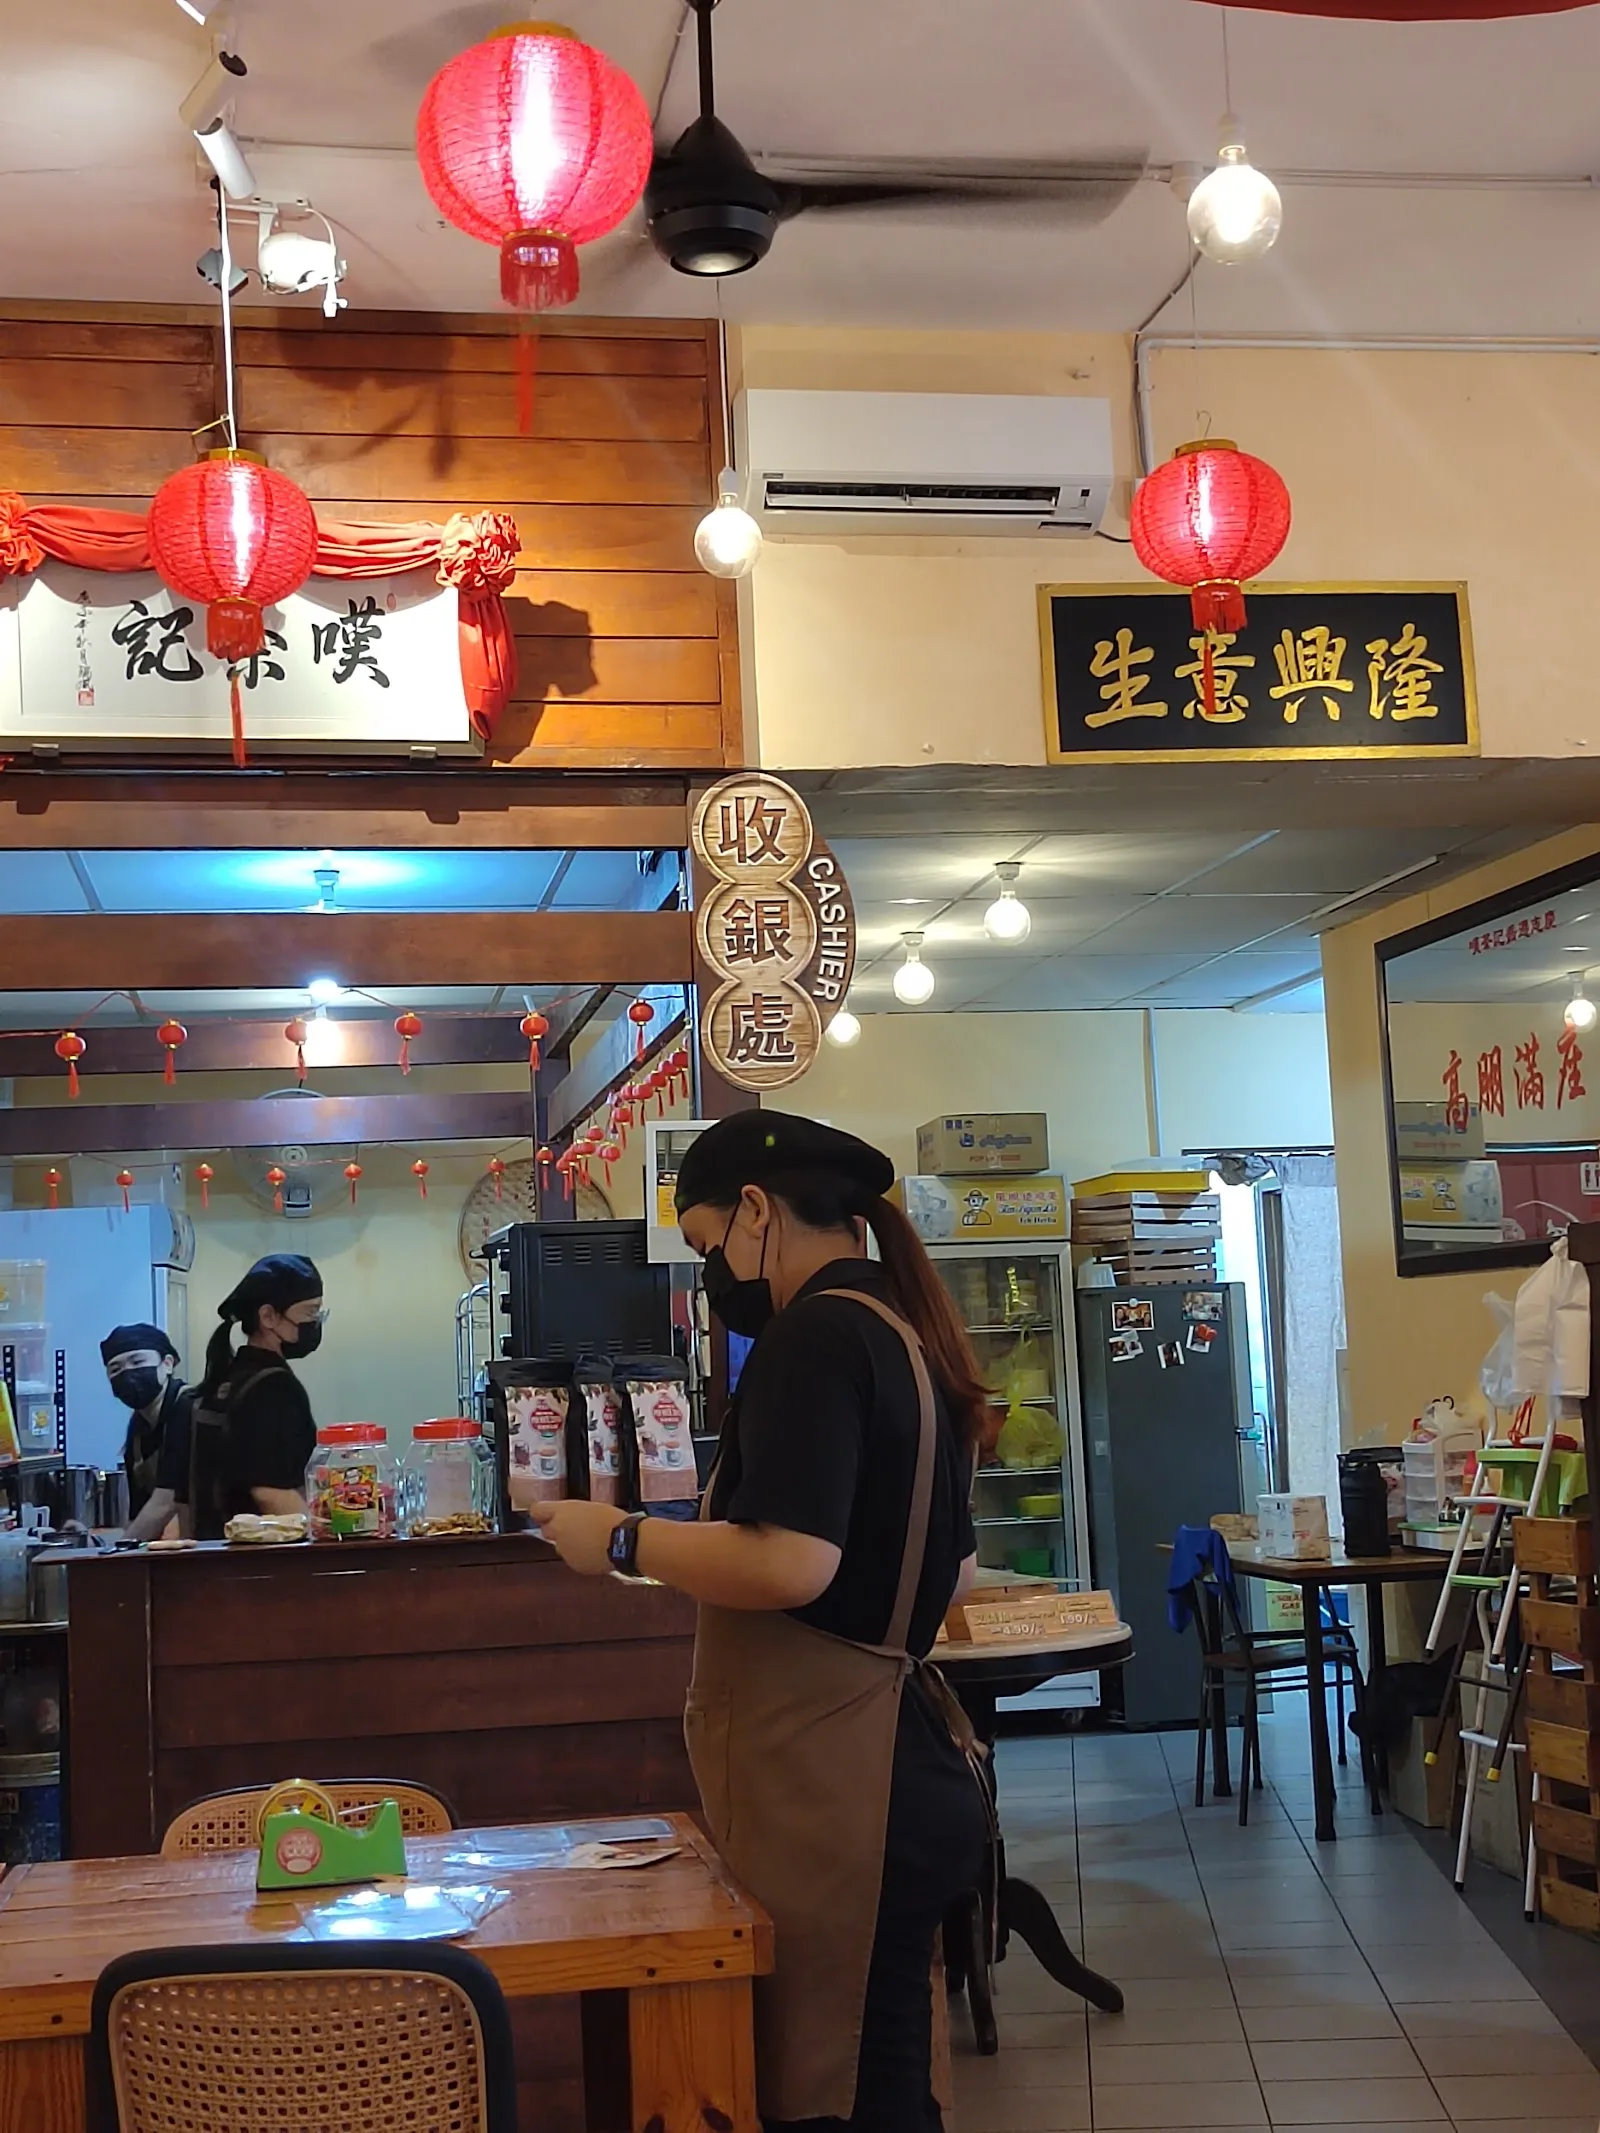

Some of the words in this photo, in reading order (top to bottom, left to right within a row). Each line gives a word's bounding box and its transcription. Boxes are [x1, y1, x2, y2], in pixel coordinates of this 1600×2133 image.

[1085, 623, 1445, 729] 生意興隆
[717, 796, 795, 1064] 收銀處
[808, 857, 848, 1001] CASHIER
